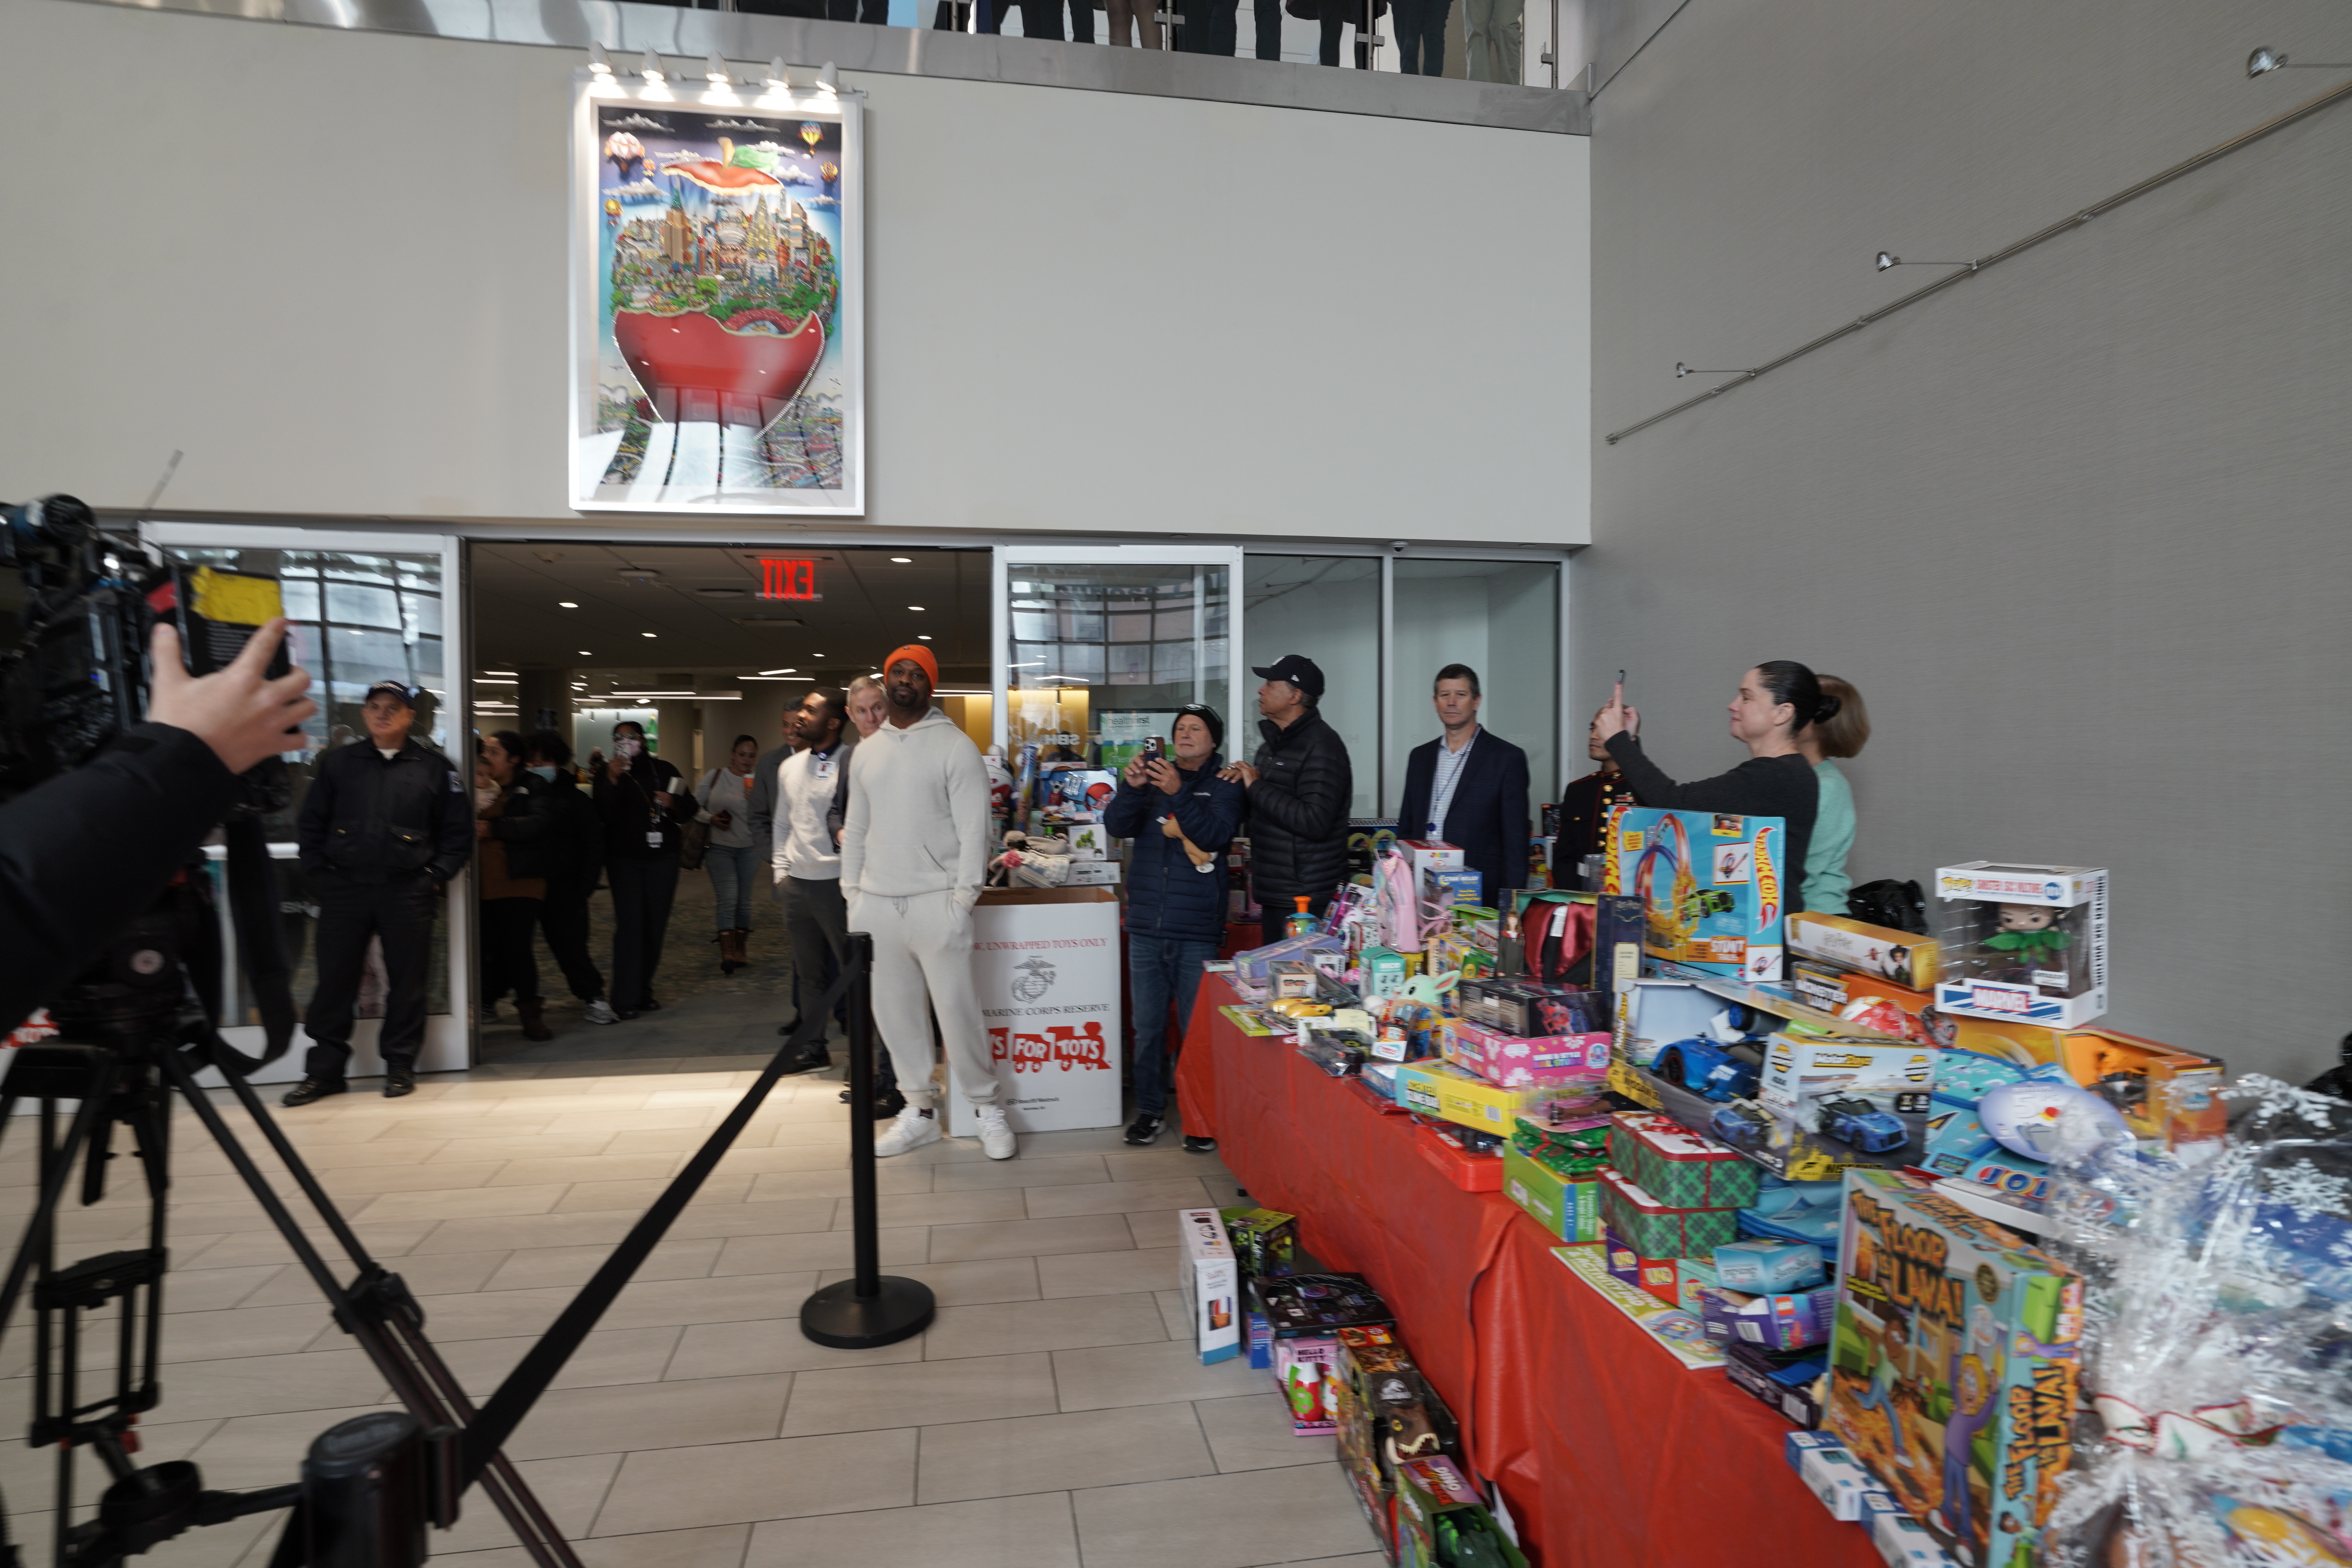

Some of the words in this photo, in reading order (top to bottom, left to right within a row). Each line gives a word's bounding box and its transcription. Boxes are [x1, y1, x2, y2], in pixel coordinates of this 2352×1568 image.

[1109, 715, 1150, 725] healthfirst
[985, 941, 1051, 950] UNWRAPPED
[1051, 939, 1079, 949] TOYS
[1080, 938, 1109, 947] ONLY
[1710, 940, 1746, 953] STUNT
[1795, 979, 1848, 1004] MONSTER
[1974, 986, 2030, 1013] MARVEL
[982, 1008, 1024, 1017] MARINE
[1025, 1006, 1062, 1016] CORPS
[1062, 1003, 1111, 1014] RESERVE
[1808, 996, 1834, 1012] JAM
[1014, 1038, 1048, 1059] FOR
[1057, 1038, 1101, 1060] TOTS
[1850, 1189, 1880, 1228] THE
[1878, 1207, 1948, 1268] FLOOR
[1611, 1251, 1637, 1267] UNO
[1643, 1267, 1674, 1286] UNO
[1891, 1251, 1965, 1331] LAVA!
[2031, 1365, 2070, 1447] LAVA!
[2007, 1384, 2038, 1463] FLOOR
[1433, 1466, 1463, 1491] DINO
